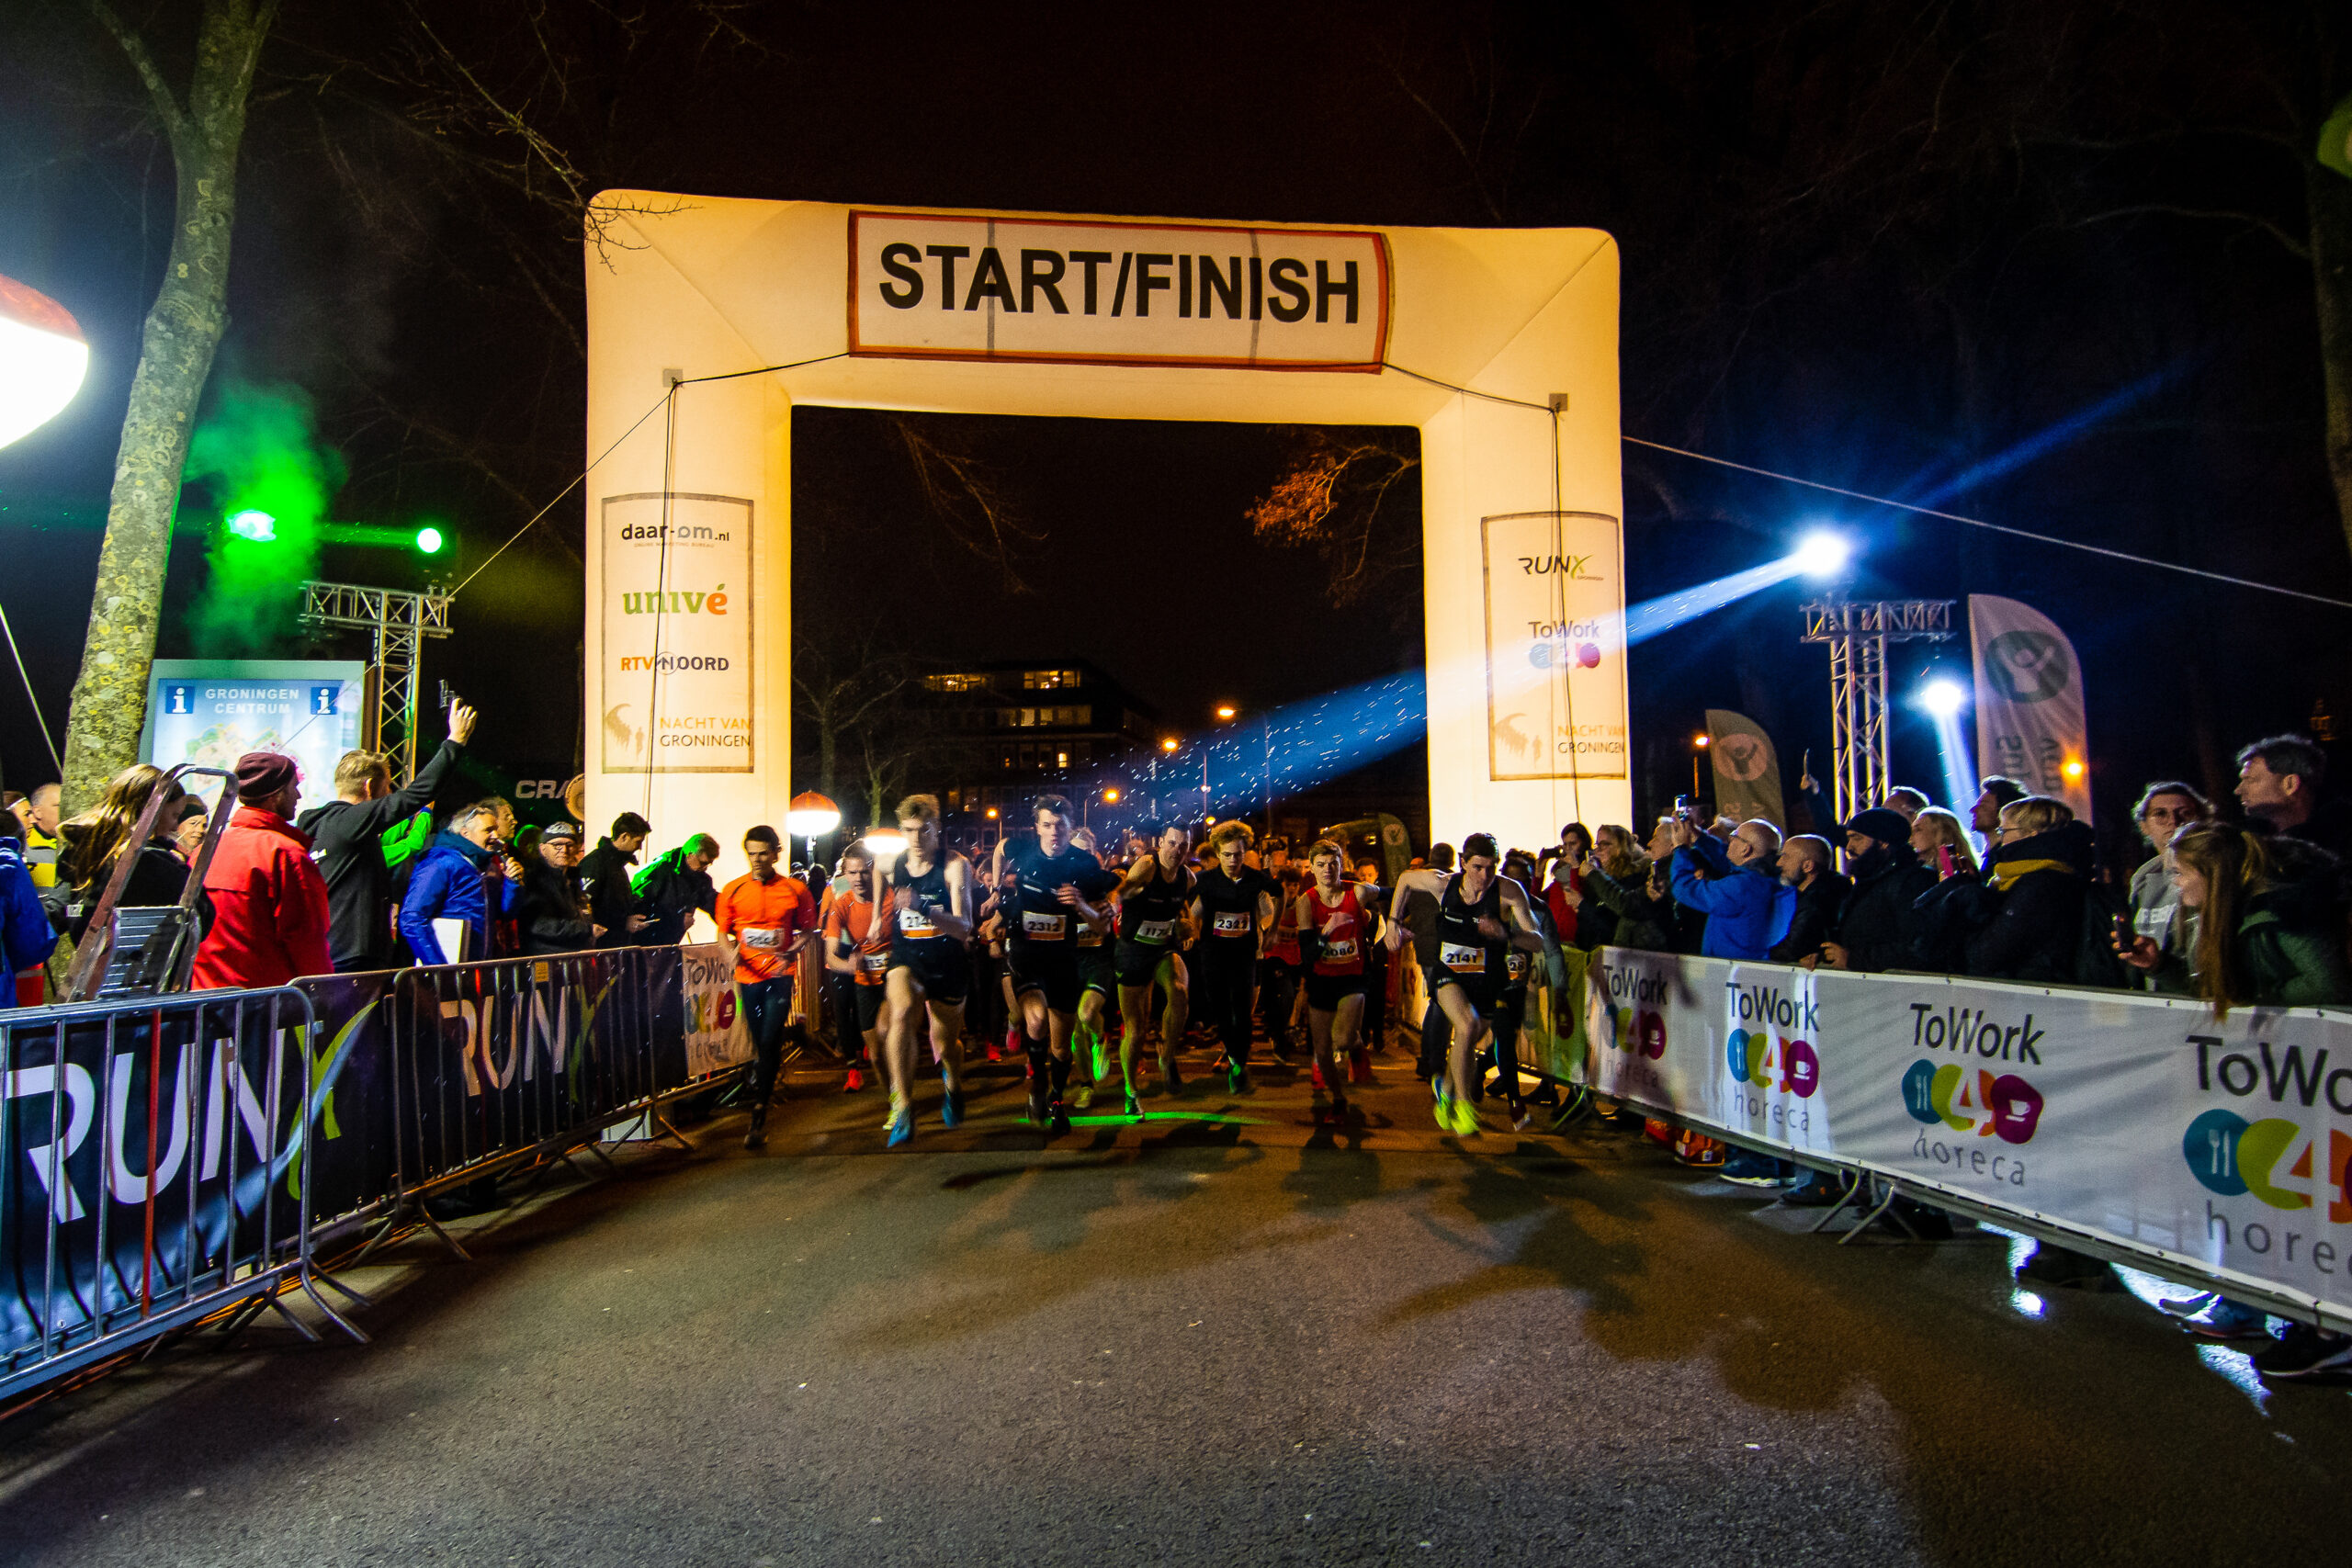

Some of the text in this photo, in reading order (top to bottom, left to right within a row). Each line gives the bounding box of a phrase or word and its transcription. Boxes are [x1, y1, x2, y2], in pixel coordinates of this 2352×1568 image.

[879, 242, 1359, 323] START/FINISH
[1518, 554, 1594, 580] RUNX
[622, 583, 728, 615] univé
[1528, 620, 1600, 638] ToWork
[205, 688, 300, 700] GRONINGEN
[214, 704, 290, 714] CENTRUM
[660, 716, 751, 730] NACHT VAN
[660, 735, 751, 747] GRONINGEN
[1557, 725, 1603, 737] NACHT
[1557, 742, 1624, 753] GRONINGEN
[1603, 964, 1668, 1005] ToWork
[1725, 981, 1820, 1032] ToWork
[439, 976, 617, 1102] RUNX
[1909, 1003, 2045, 1066] ToWork
[5, 1000, 379, 1224] RUNX
[1734, 1085, 1810, 1132] horeca
[1913, 1127, 2025, 1188] horeca
[2206, 1200, 2352, 1275] hore
